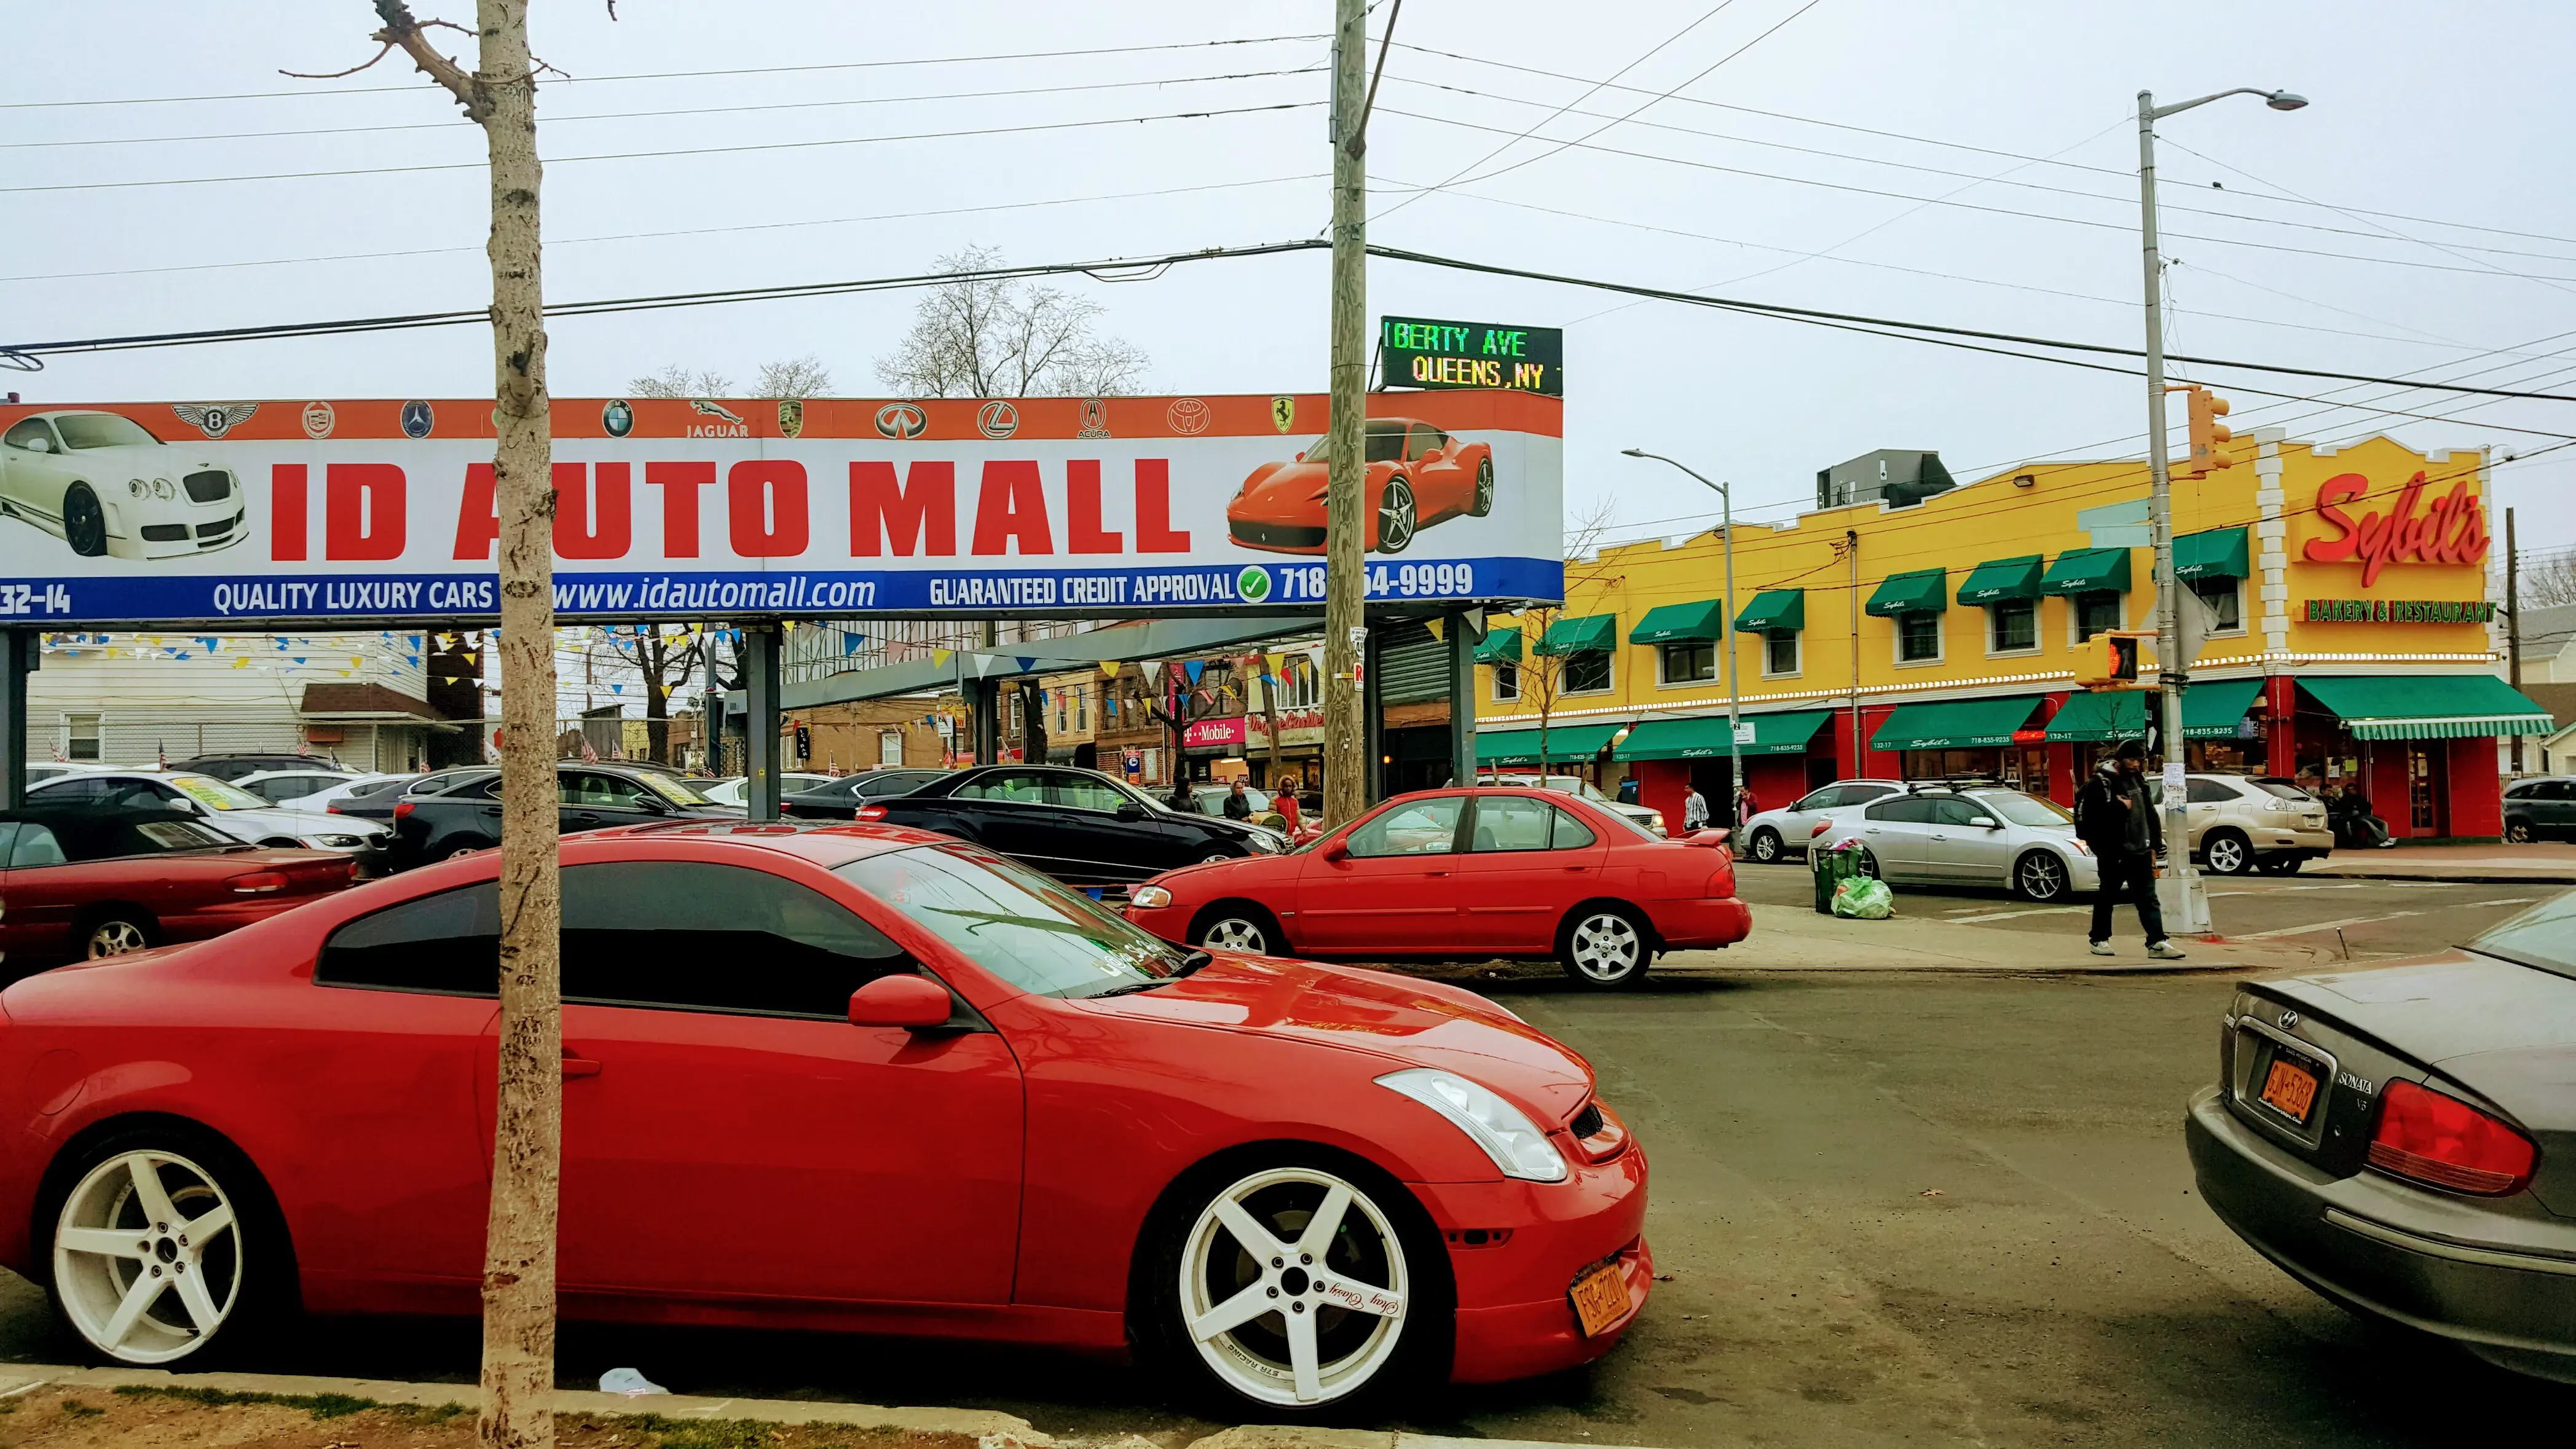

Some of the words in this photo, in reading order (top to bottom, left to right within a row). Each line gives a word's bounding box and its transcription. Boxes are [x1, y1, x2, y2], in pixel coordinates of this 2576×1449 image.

[1483, 329, 1527, 356] AVE
[686, 425, 749, 438] JAGUAR
[1077, 430, 1111, 438] ACURA
[271, 463, 406, 561] ID
[849, 458, 1190, 557] MALL
[2302, 471, 2490, 587] Sybil's
[214, 582, 319, 615] QUALITY
[326, 582, 422, 609] LUXURY
[428, 583, 492, 608] CARS
[552, 576, 875, 609] www.idautomall.com
[930, 578, 1056, 605] GUARANTEED
[1063, 575, 1126, 603] CREDIT
[1133, 572, 1235, 602] APPROVAL
[2307, 600, 2373, 622] BAKERY
[2377, 600, 2388, 622] &
[2395, 600, 2497, 622] RESTAURANT
[1910, 739, 1950, 748] Sybil's
[2339, 1072, 2373, 1096] SONATA
[2357, 1098, 2367, 1111] V6
[1328, 1282, 1364, 1310] Classy
[1369, 1292, 1398, 1314] Stay
[1227, 1344, 1258, 1371] RACING
[1260, 1366, 1279, 1377] STR
